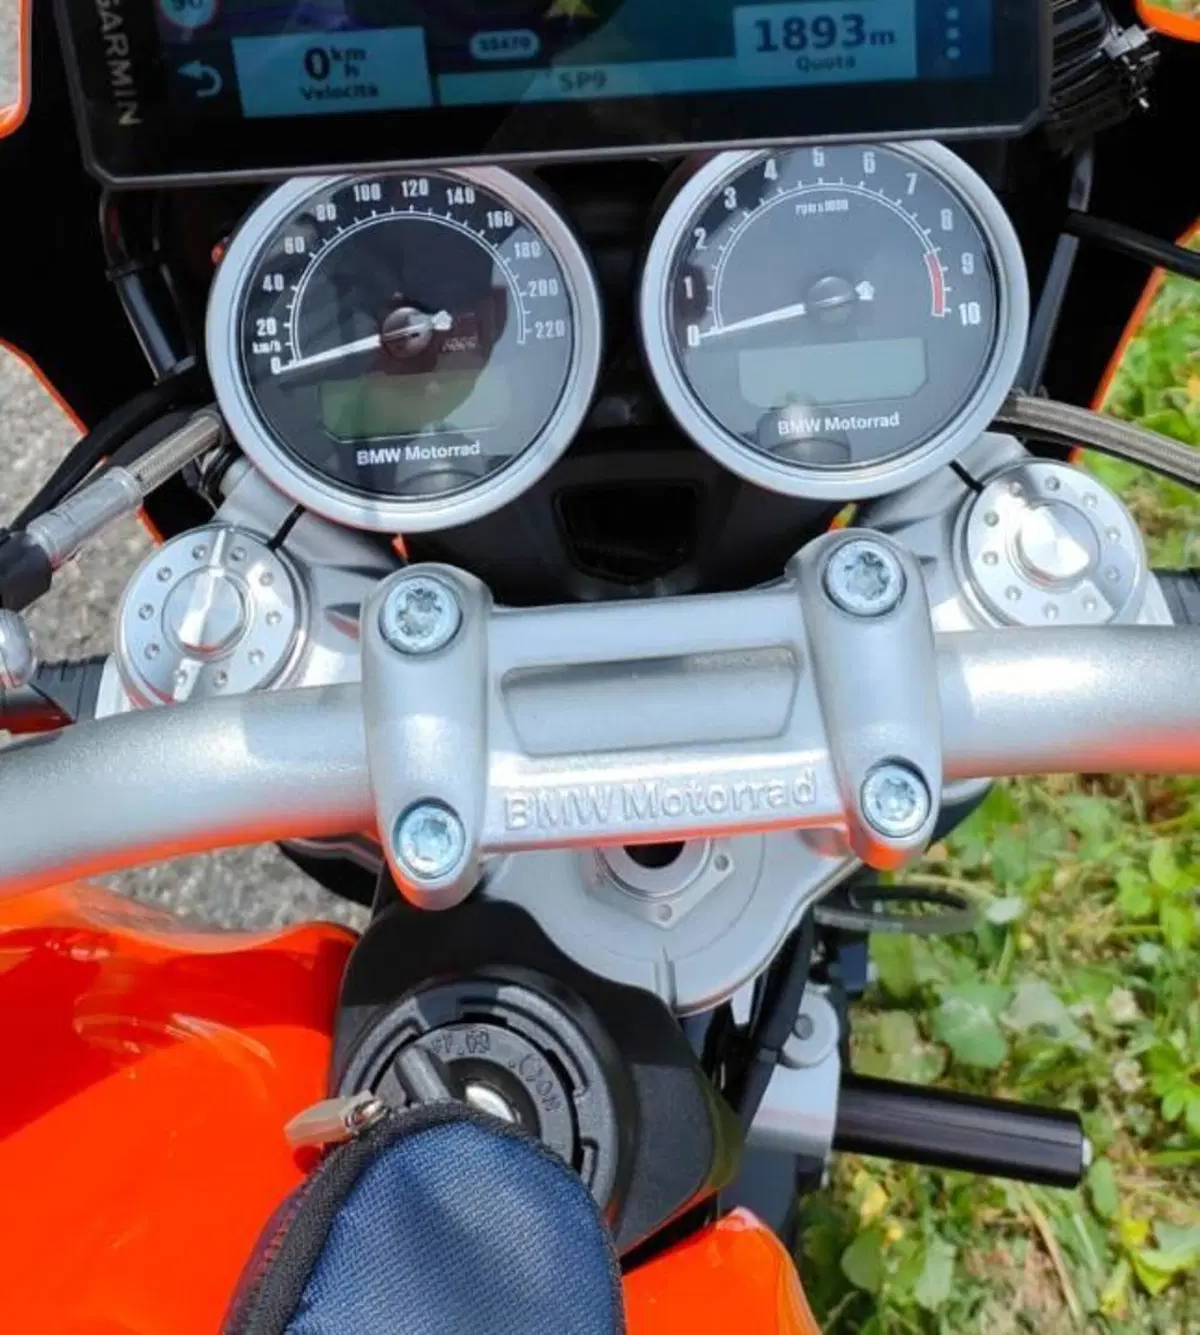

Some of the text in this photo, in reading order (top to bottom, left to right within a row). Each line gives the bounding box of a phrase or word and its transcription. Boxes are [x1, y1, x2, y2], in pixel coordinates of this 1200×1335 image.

[304, 47, 330, 80] 0
[795, 54, 856, 73] Quota
[812, 148, 825, 167] 5
[862, 151, 876, 173] 6
[764, 159, 777, 180] 4
[353, 182, 381, 202] 100
[401, 178, 429, 198] 120
[905, 172, 918, 195] 7
[446, 185, 475, 205] 140
[724, 187, 737, 210] 3
[316, 203, 336, 221] 80
[487, 210, 514, 229] 160
[940, 209, 954, 231] 8
[284, 235, 305, 253] 60
[694, 228, 707, 250] 2
[514, 241, 541, 259] 180
[961, 253, 974, 275] 9
[263, 273, 284, 291] 40
[528, 279, 558, 297] 200
[684, 276, 693, 298] 1
[959, 302, 982, 325] 10
[256, 318, 277, 336] 20
[534, 319, 565, 339] 220
[687, 325, 699, 347] 0
[252, 339, 281, 355] km/h
[270, 357, 282, 375] 0
[777, 411, 900, 436] BMW Motorrad
[356, 440, 481, 466] BMW Motorrad
[505, 767, 817, 831] BMW Motorrad
